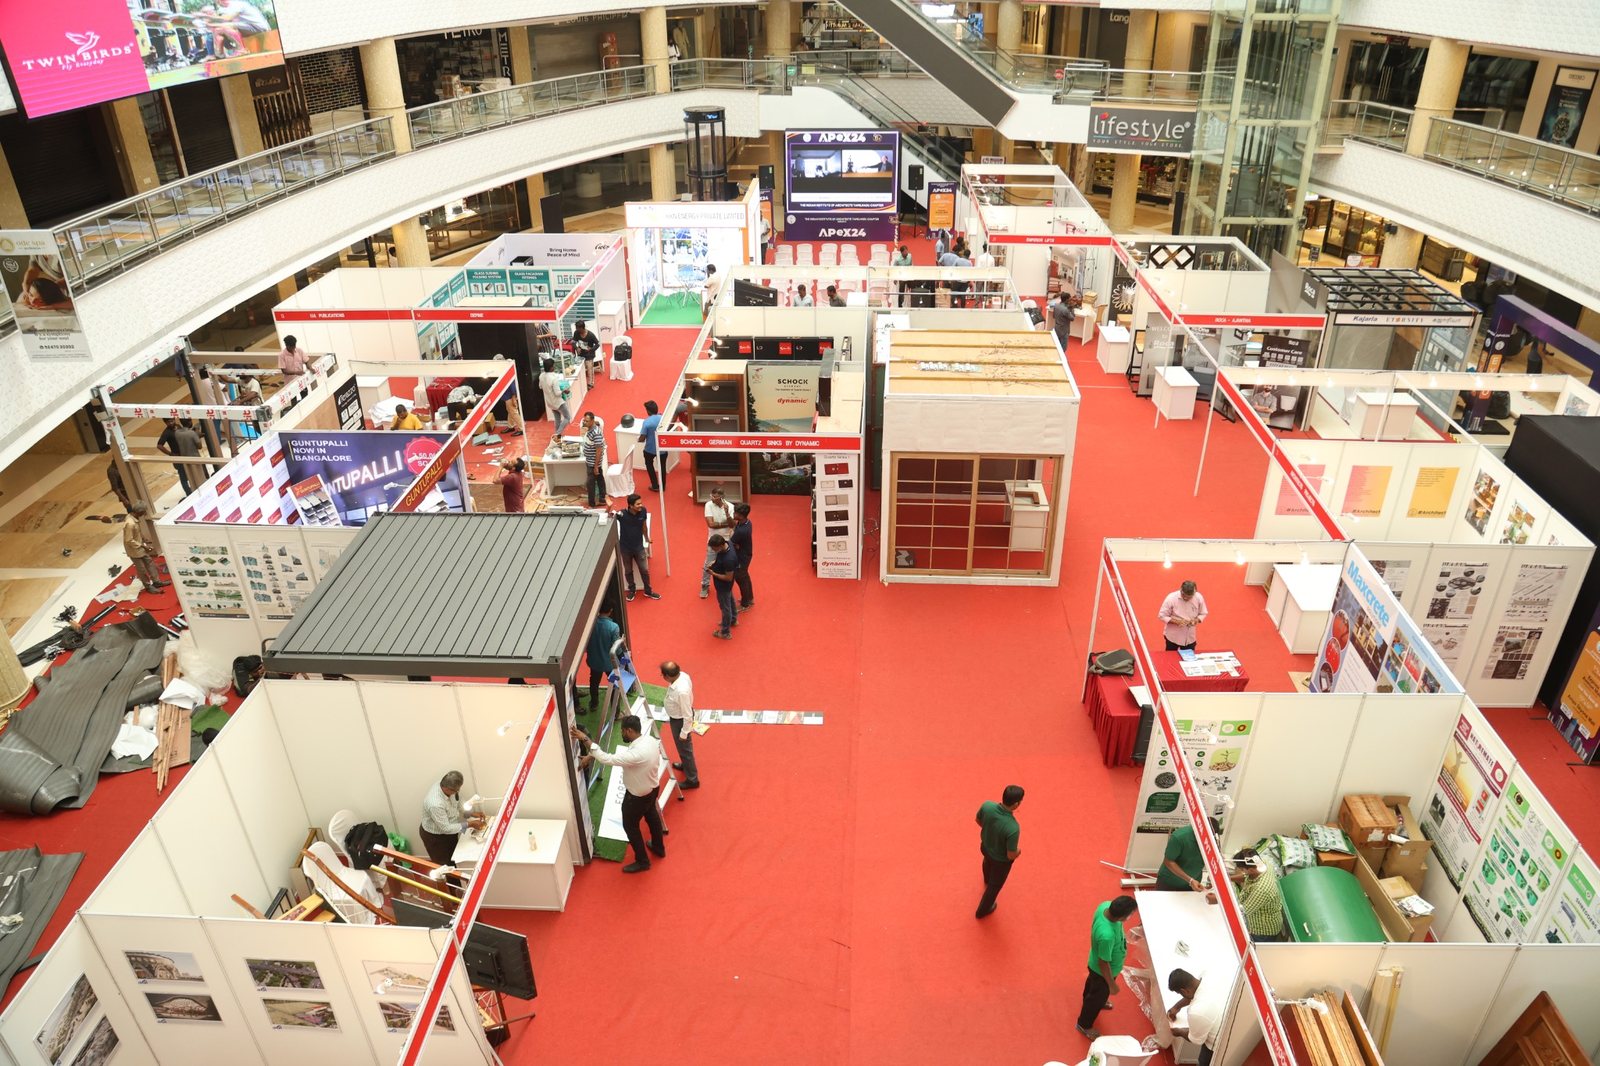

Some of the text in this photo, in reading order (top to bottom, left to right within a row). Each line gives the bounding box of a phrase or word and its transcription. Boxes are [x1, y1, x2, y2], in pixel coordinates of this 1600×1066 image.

[22, 44, 133, 71] TWIN BIRDS
[1093, 112, 1186, 143] lifestyle
[1266, 345, 1291, 354] Customer
[291, 439, 349, 447] GUNTUPALLI
[708, 438, 733, 446] GERMAN
[295, 454, 352, 462] BANGALORE
[405, 458, 443, 507] GUNTUPALLI
[1347, 559, 1390, 628] Maxcrete
[496, 819, 507, 846] METAL
[506, 791, 518, 819] CRAFT
[1203, 836, 1212, 854] PVT
[1210, 855, 1218, 875] LTD
